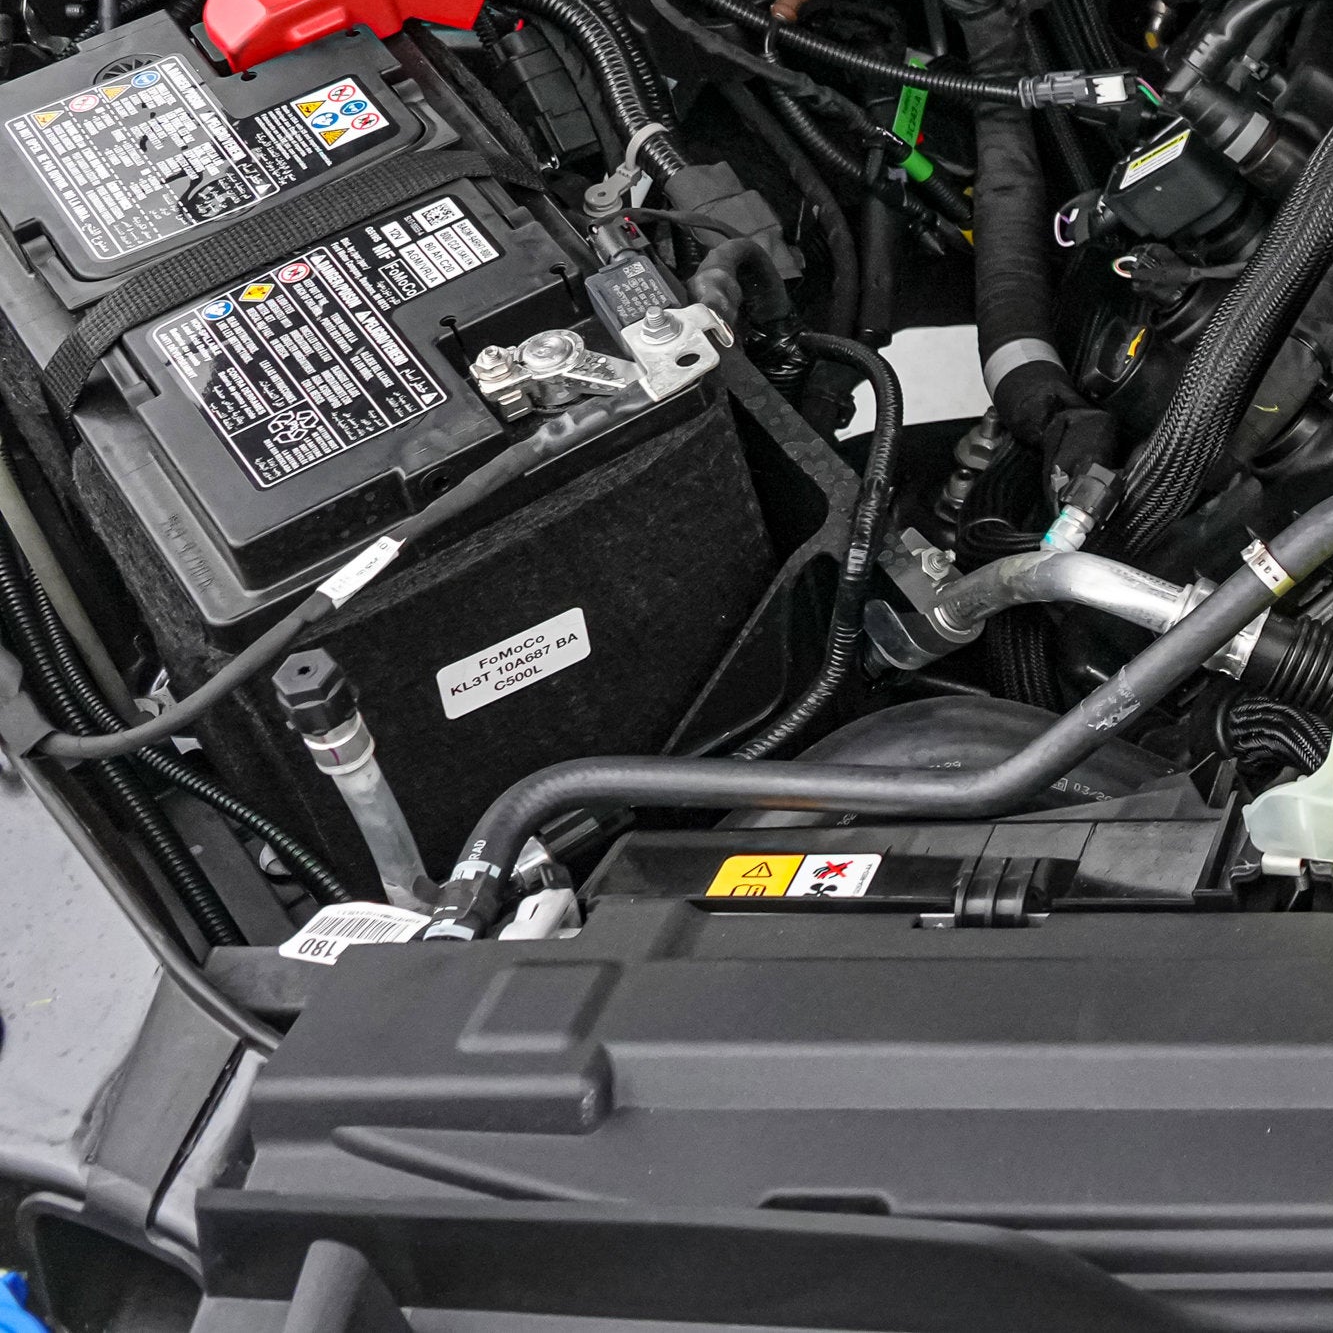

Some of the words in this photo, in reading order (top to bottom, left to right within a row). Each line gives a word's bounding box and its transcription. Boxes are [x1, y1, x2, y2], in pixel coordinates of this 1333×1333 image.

[387, 227, 404, 241] 12V
[370, 242, 396, 262] MF
[423, 241, 437, 251] 80
[431, 250, 444, 260] Ah
[438, 258, 455, 273] C20
[383, 262, 420, 297] FoMoCo
[314, 258, 363, 309] DANGER/POISON
[359, 315, 410, 367] PELIGRO/VENENO
[240, 386, 266, 415] DERRAMES
[450, 672, 491, 696] KL3T
[497, 644, 551, 675] 10A687
[555, 633, 578, 649] BA
[478, 635, 545, 669] FoMoCo
[494, 665, 543, 691] C500L
[470, 838, 487, 863] RAD
[297, 936, 337, 957] 180
